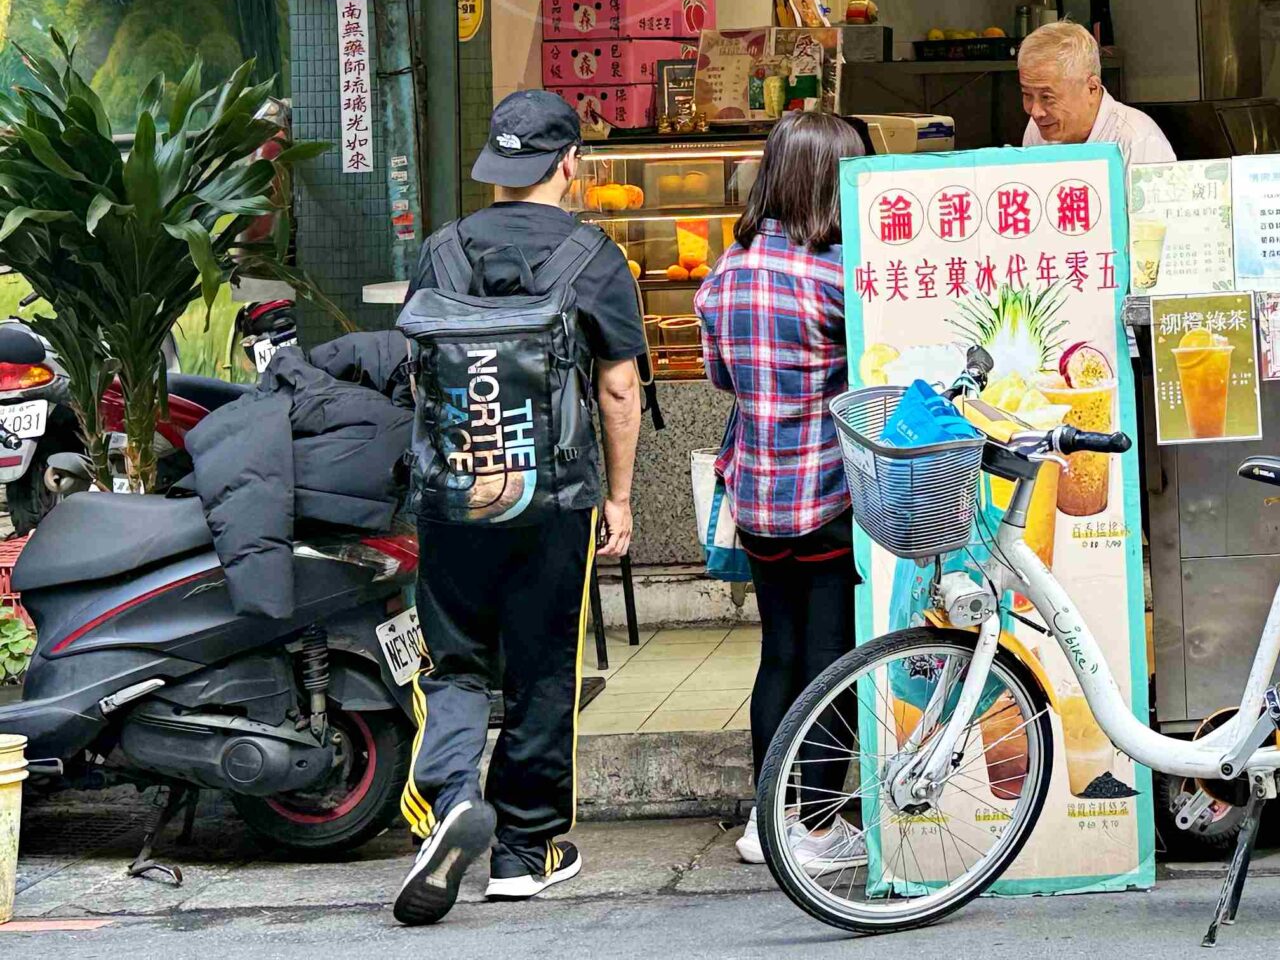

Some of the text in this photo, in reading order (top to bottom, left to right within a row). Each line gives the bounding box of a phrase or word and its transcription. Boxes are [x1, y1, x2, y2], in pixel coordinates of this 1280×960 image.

[1160, 310, 1248, 336] 柳橙綠茶
[467, 349, 506, 473] NORTH
[502, 398, 537, 469] THE
